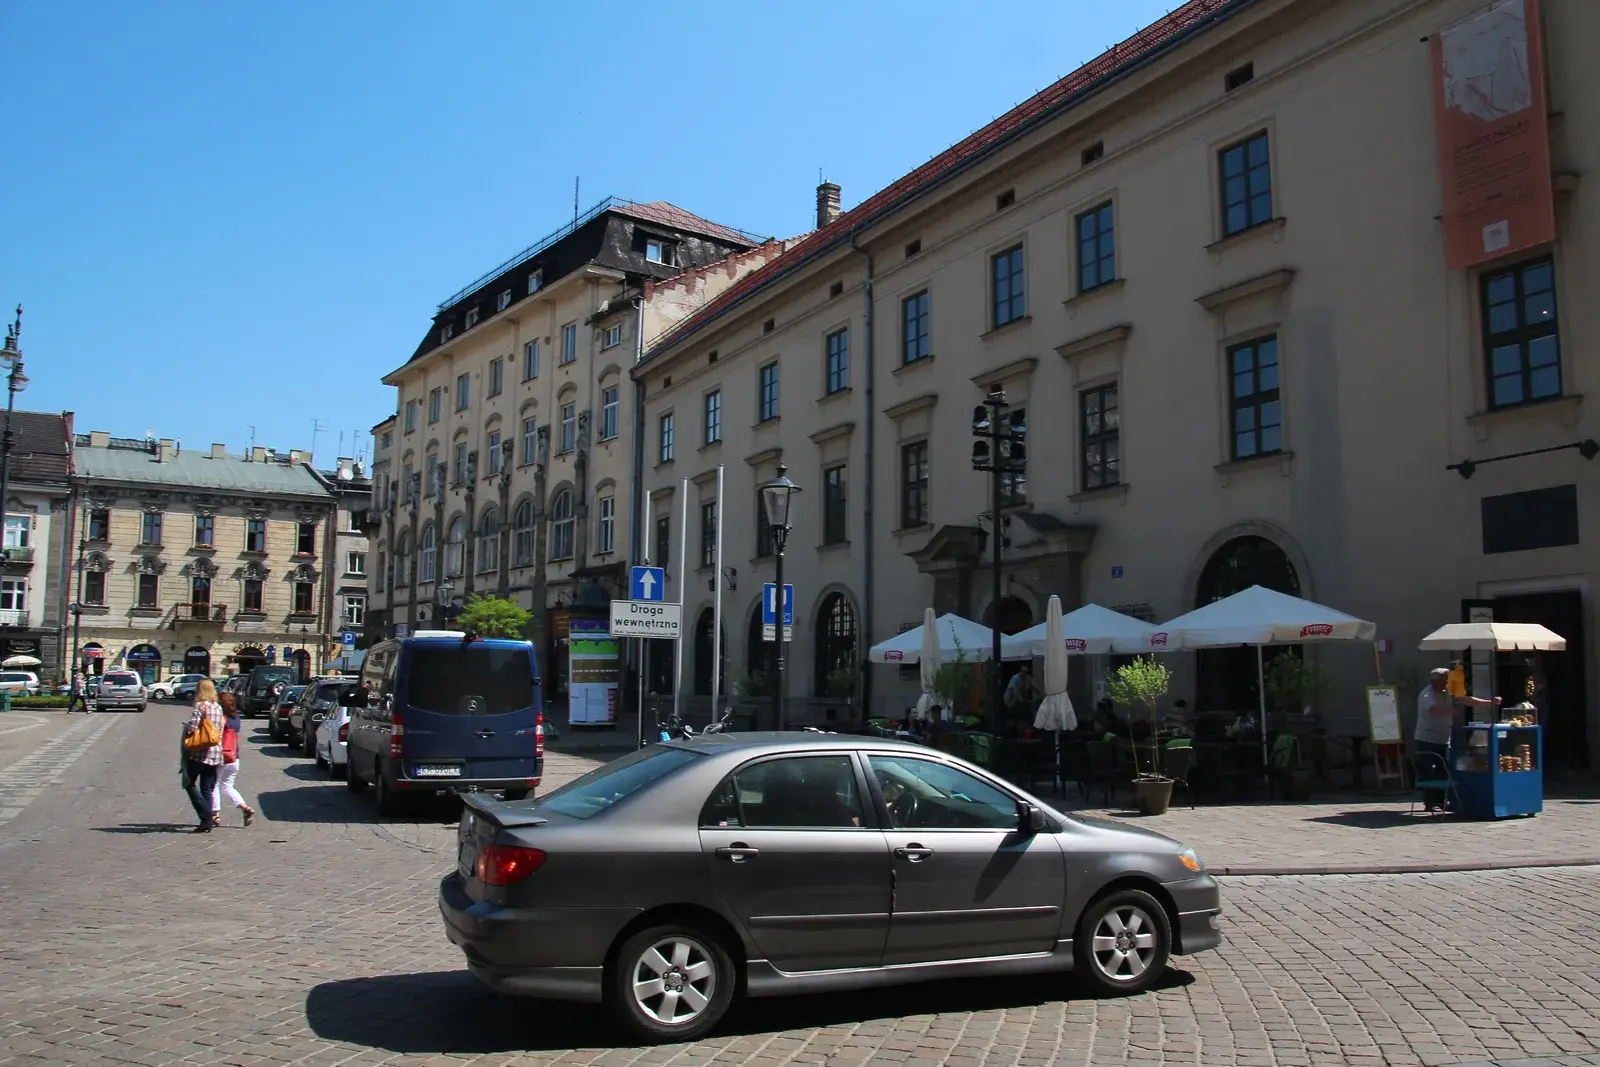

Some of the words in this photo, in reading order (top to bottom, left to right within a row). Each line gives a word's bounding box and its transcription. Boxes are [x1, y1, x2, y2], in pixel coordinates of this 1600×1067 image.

[631, 604, 663, 616] Droga
[615, 619, 678, 630] wewnętrzna
[345, 634, 352, 643] P
